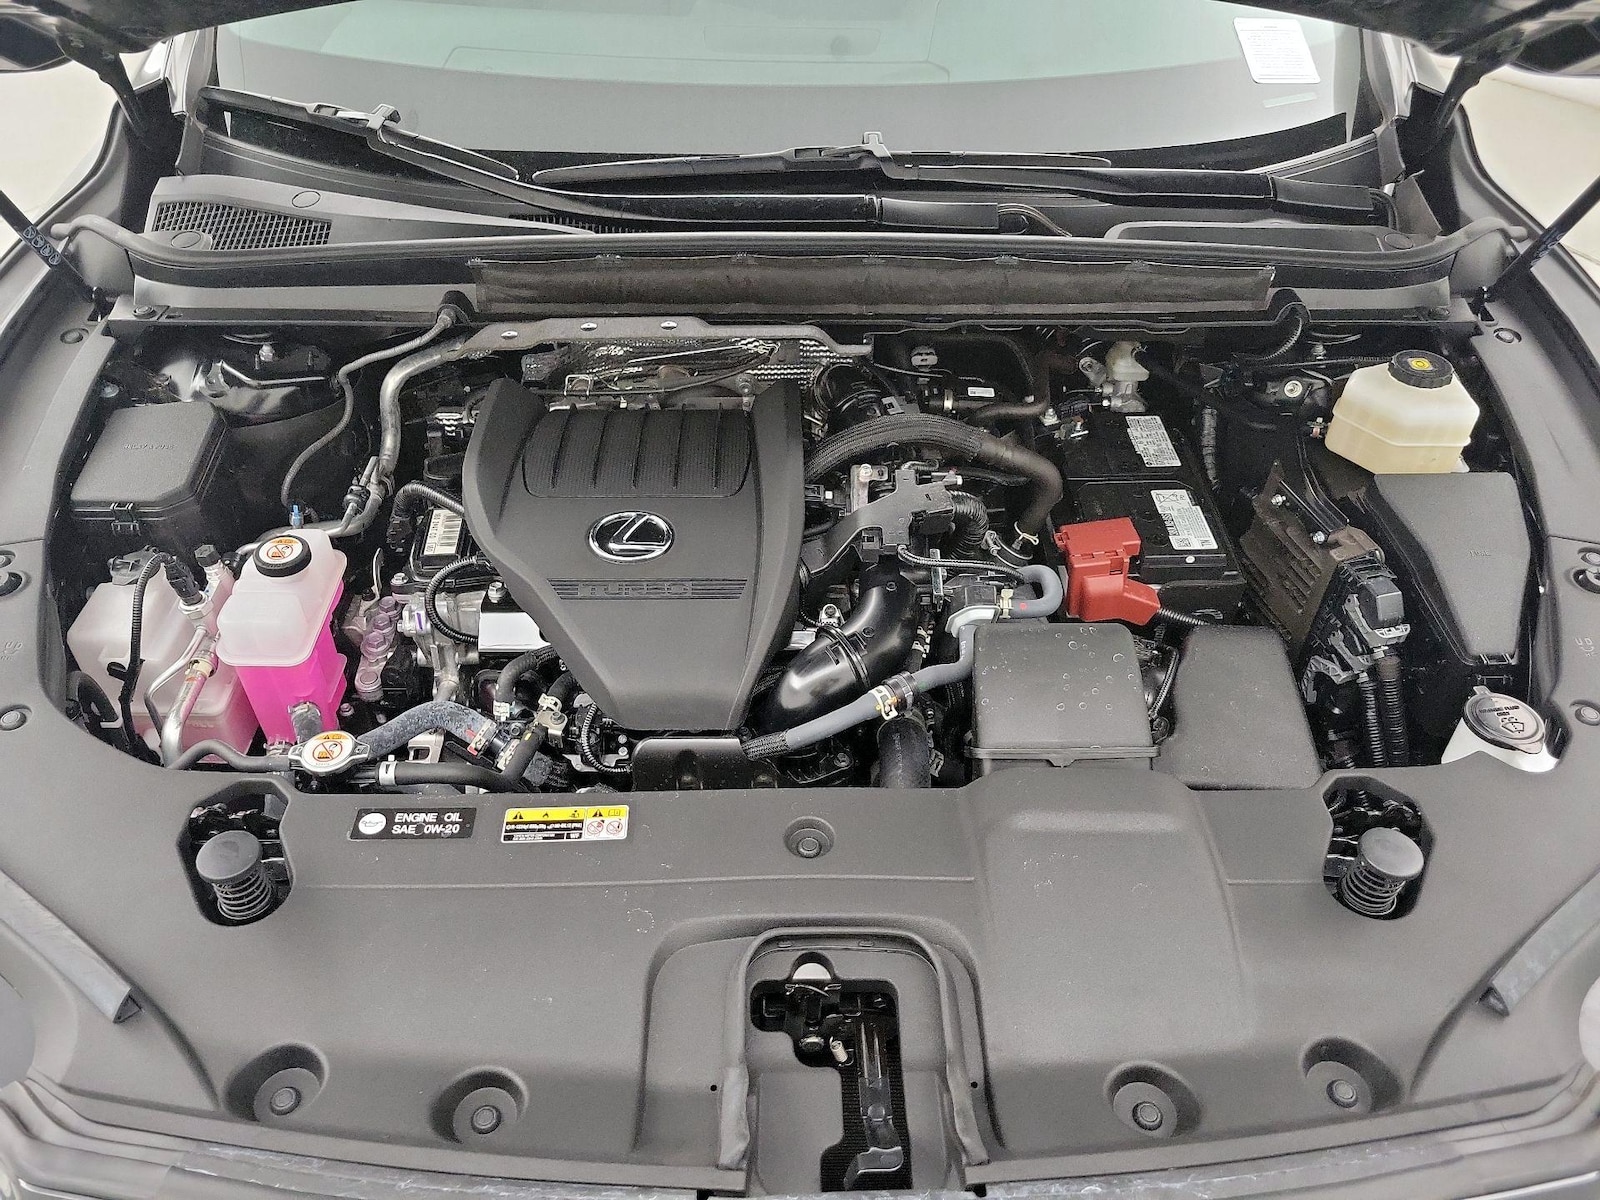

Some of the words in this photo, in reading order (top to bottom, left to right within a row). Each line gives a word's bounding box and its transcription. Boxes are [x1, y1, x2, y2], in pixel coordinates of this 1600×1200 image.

[582, 583, 690, 596] TURBO
[394, 812, 439, 823] ENGINE
[444, 812, 464, 822] OIL
[391, 824, 416, 834] SAE
[423, 823, 460, 834] 0W-20
